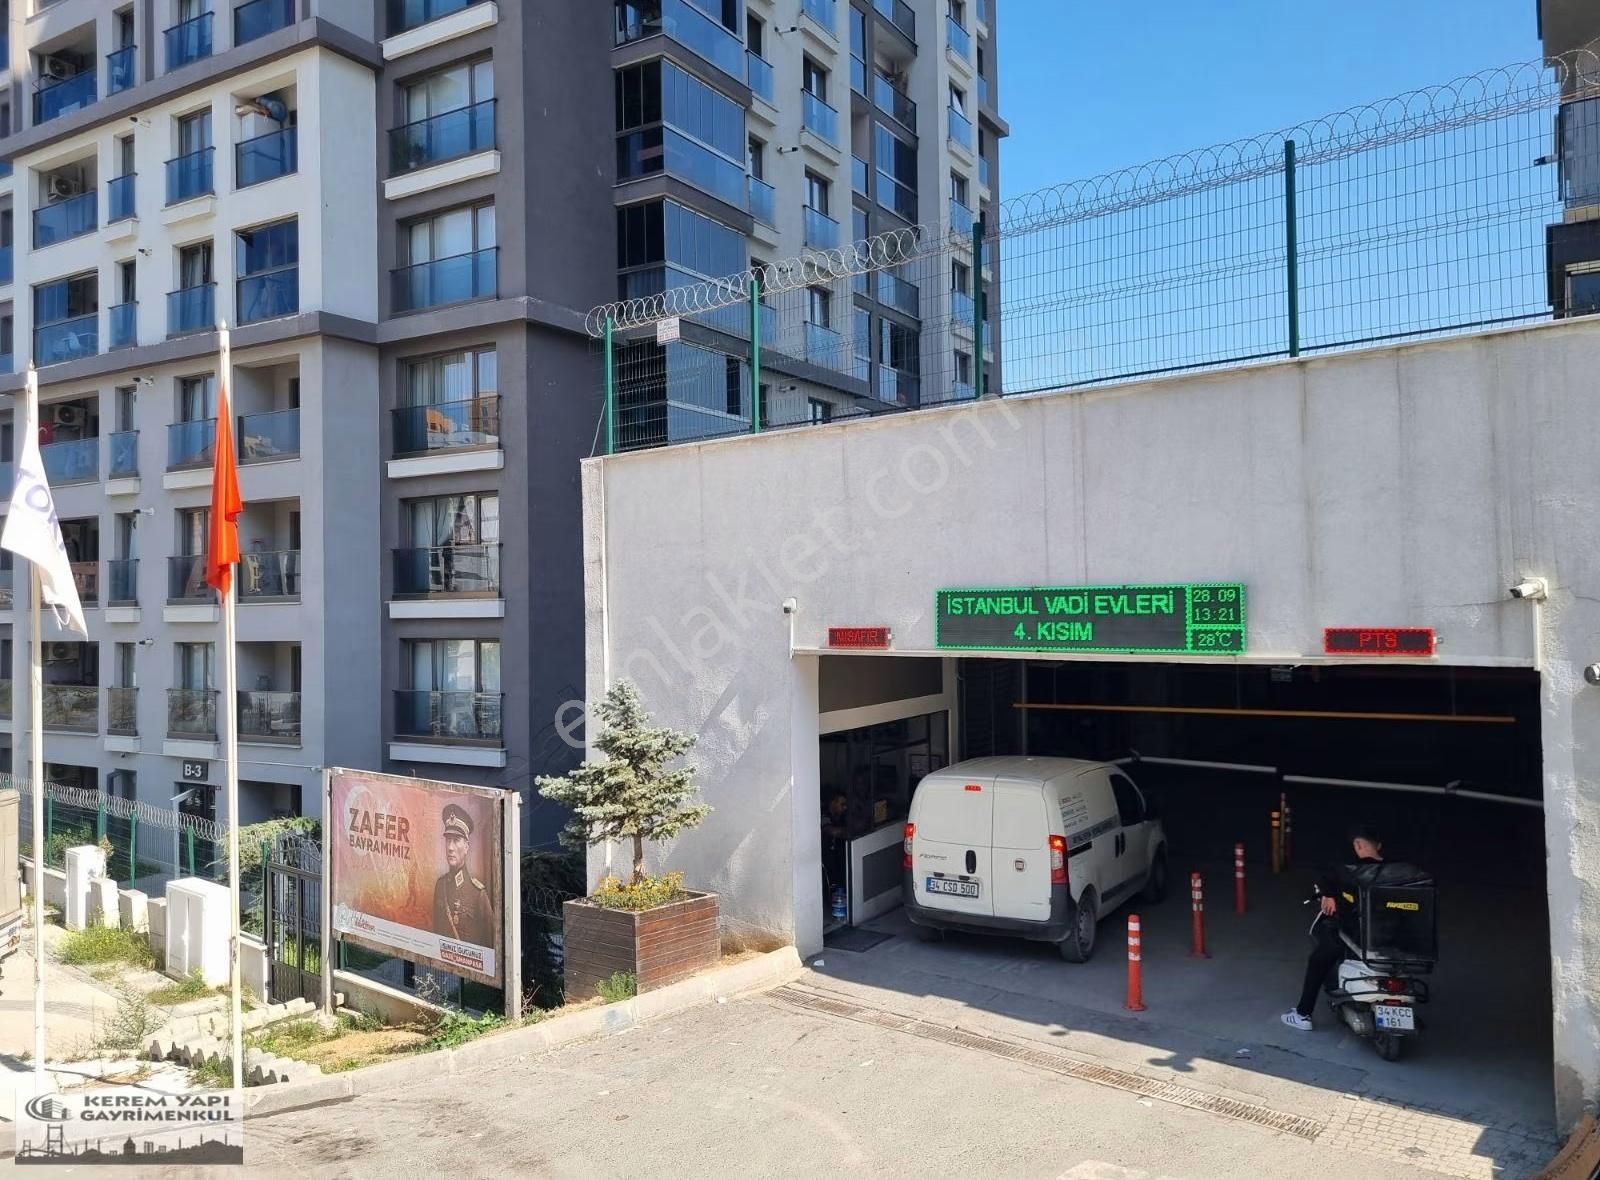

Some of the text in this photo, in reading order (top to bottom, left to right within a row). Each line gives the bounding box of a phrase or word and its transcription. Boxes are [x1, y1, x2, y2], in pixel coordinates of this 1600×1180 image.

[947, 590, 1174, 615] İSTANBUL VADİ EVLERİ
[1193, 590, 1236, 602] 28.09
[1194, 608, 1235, 621] 13:21
[1014, 622, 1092, 641] 4. KISIM
[1360, 632, 1397, 648] PTS
[184, 764, 202, 777] B-3
[349, 807, 410, 843] ZAFER
[349, 834, 411, 860] BAYRAMIMIZ
[943, 881, 958, 893] CSD
[961, 883, 976, 895] 500
[1386, 1018, 1402, 1027] 161
